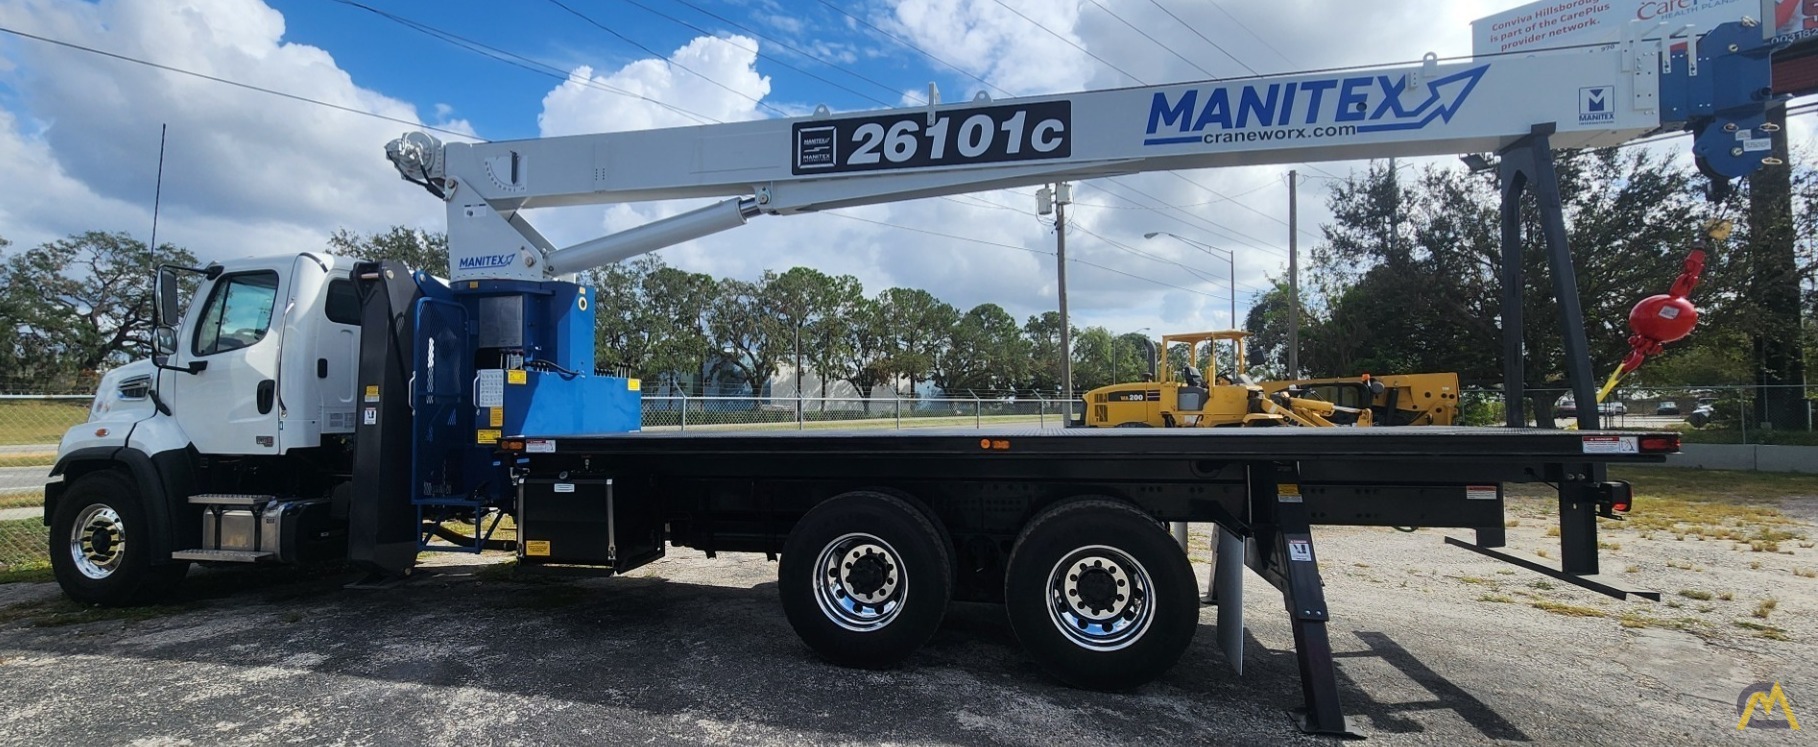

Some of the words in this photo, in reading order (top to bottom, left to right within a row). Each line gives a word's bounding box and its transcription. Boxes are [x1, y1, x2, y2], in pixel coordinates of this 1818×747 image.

[1490, 35, 1499, 43] is
[1501, 29, 1523, 42] part
[1525, 24, 1537, 33] of
[1539, 17, 1558, 29] the
[1560, 3, 1610, 22] CarePlus
[1492, 14, 1532, 31] Conviva
[1661, 7, 1698, 20] HEALTH
[1501, 33, 1546, 52] provider
[1548, 17, 1601, 37] network.
[1146, 74, 1407, 135] MANITEX
[1579, 113, 1615, 121] MANITEX
[1203, 123, 1357, 145] craneworx.com
[459, 254, 505, 268] MANITEX
